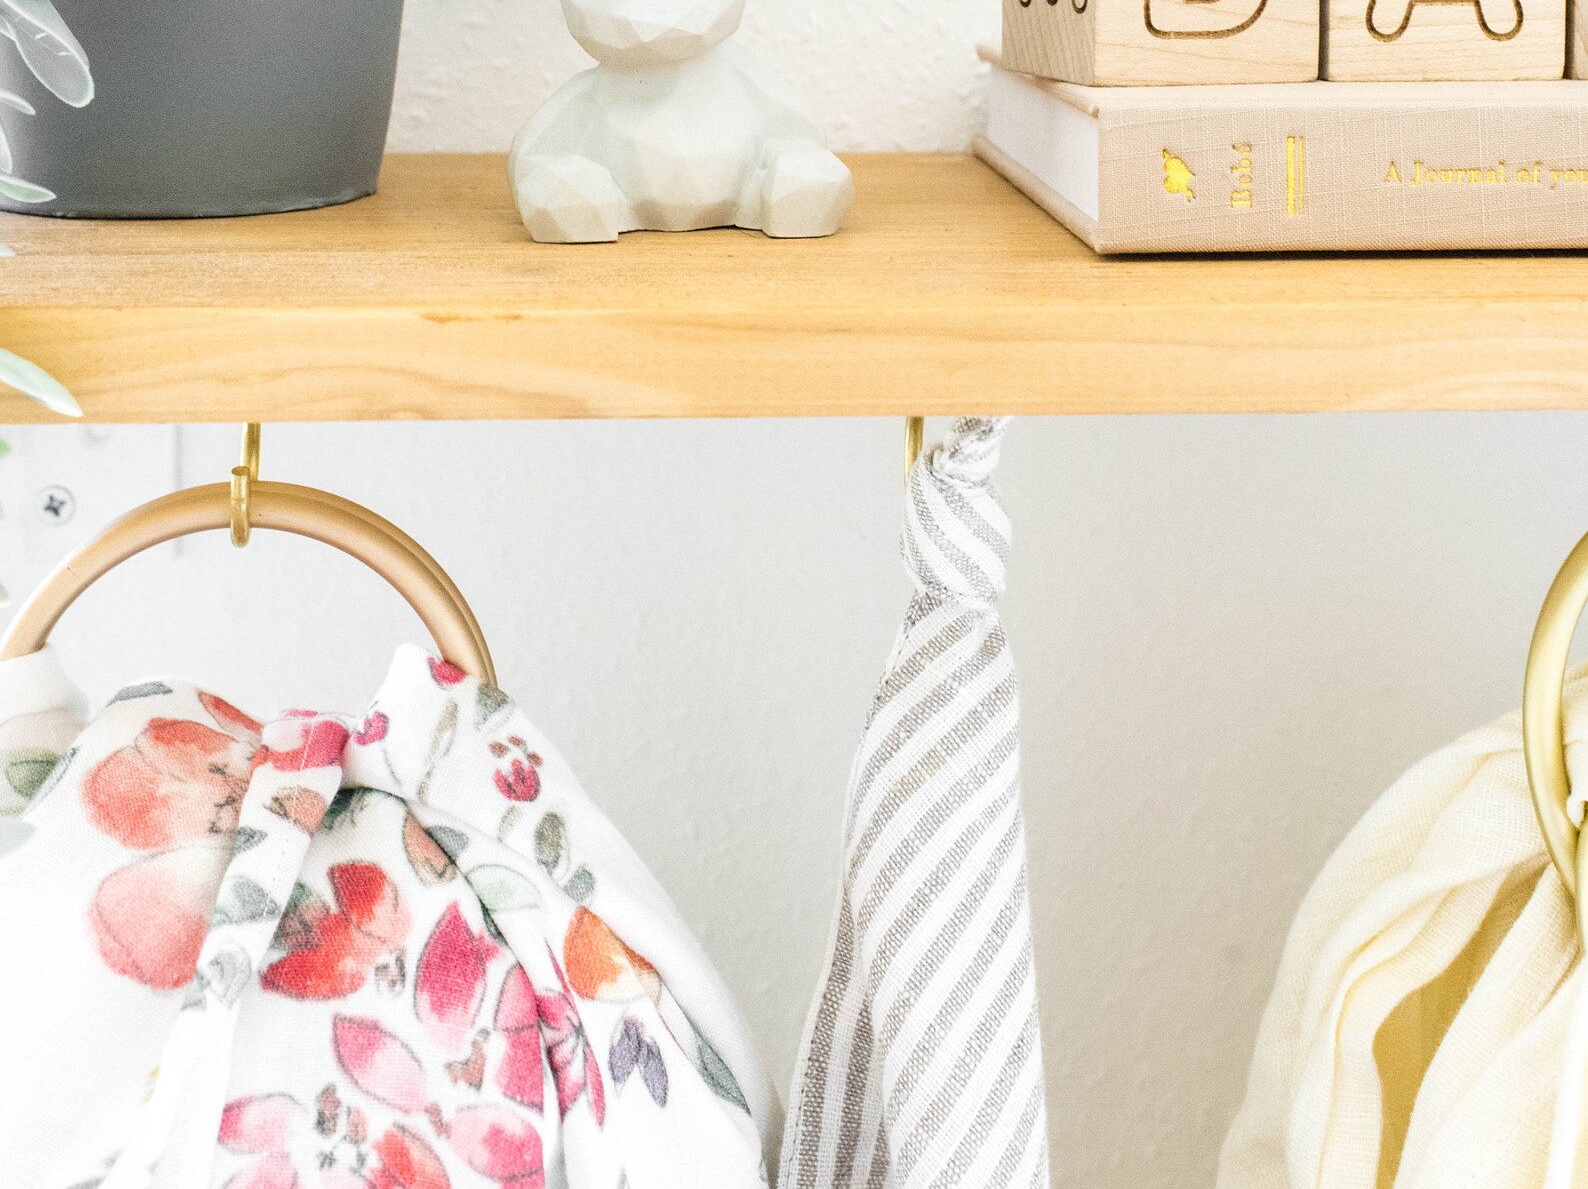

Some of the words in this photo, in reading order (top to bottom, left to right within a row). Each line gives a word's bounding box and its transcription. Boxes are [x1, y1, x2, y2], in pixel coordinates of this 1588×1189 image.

[1384, 161, 1402, 183] A
[1411, 160, 1507, 185] Journal
[1516, 160, 1543, 183] of
